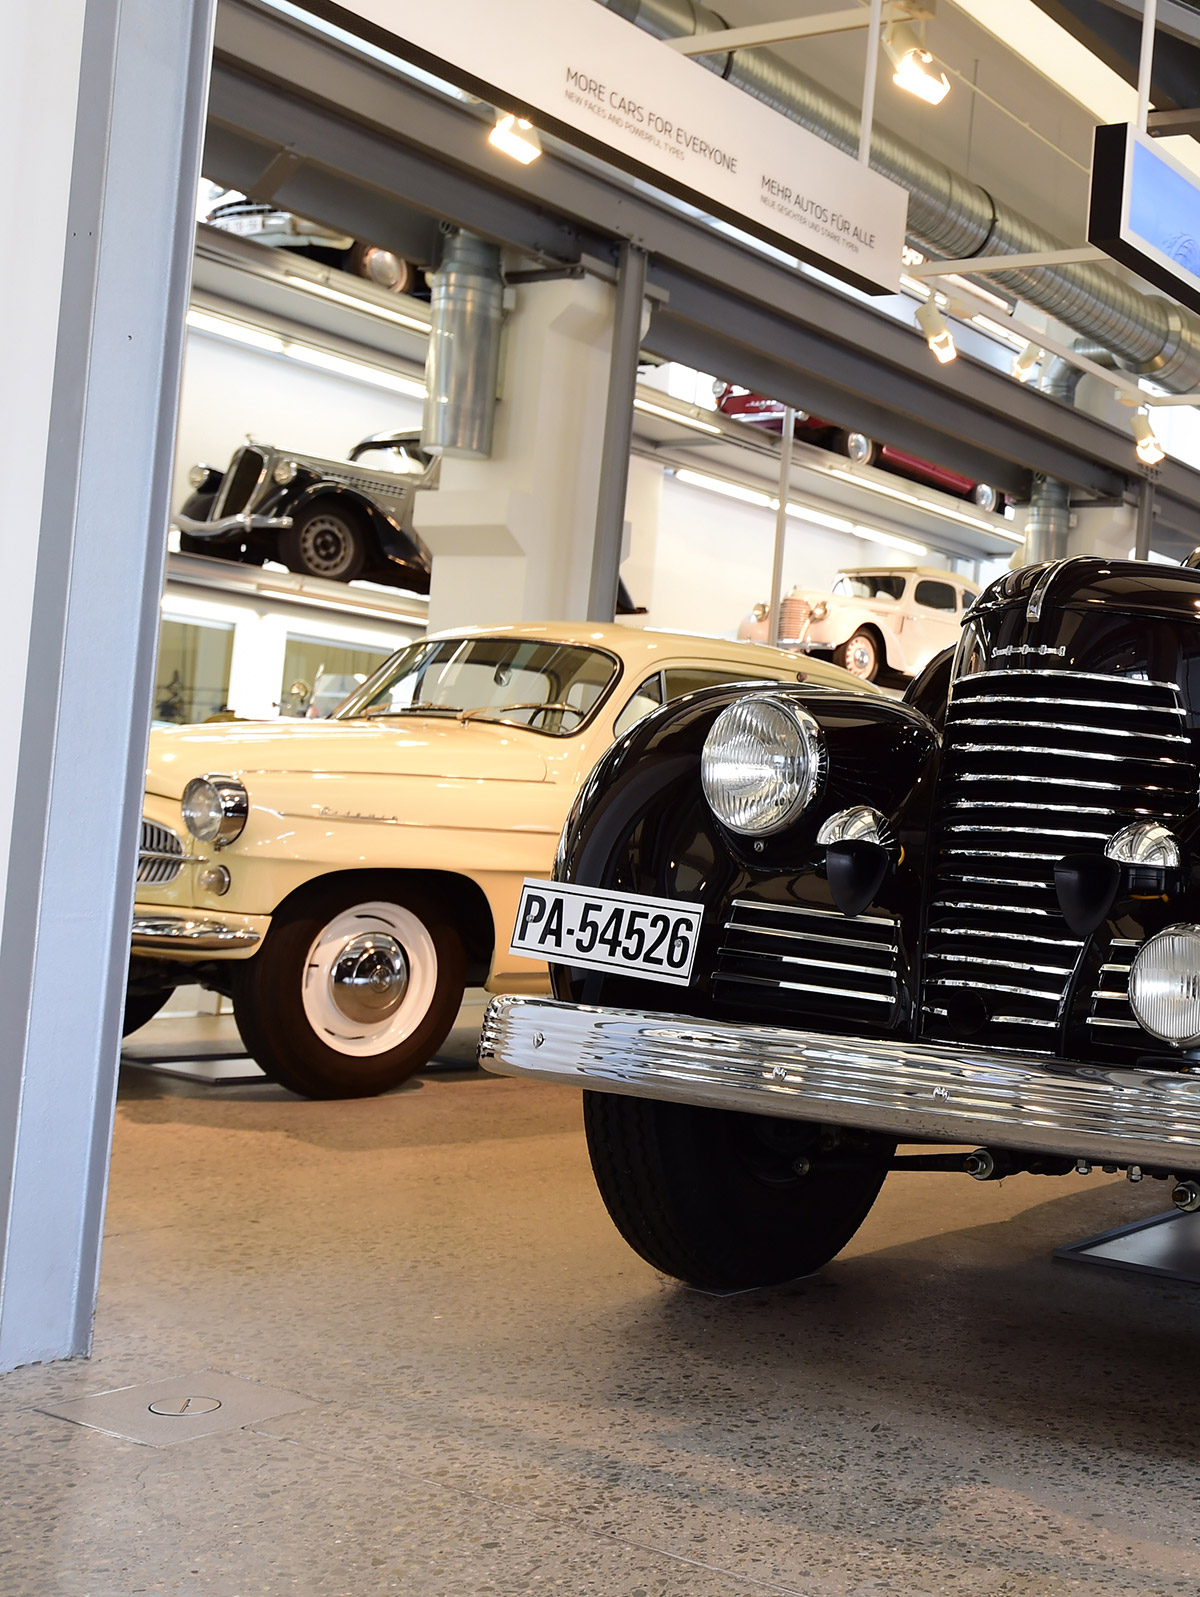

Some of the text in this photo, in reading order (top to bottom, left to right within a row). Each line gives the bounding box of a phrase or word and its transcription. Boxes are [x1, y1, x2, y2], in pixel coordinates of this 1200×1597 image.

[566, 67, 738, 174] MORE CARS FOR EVERYONE
[761, 175, 875, 249] MEHR AUTOS FÜR ALLE
[517, 894, 694, 969] PA-54526
